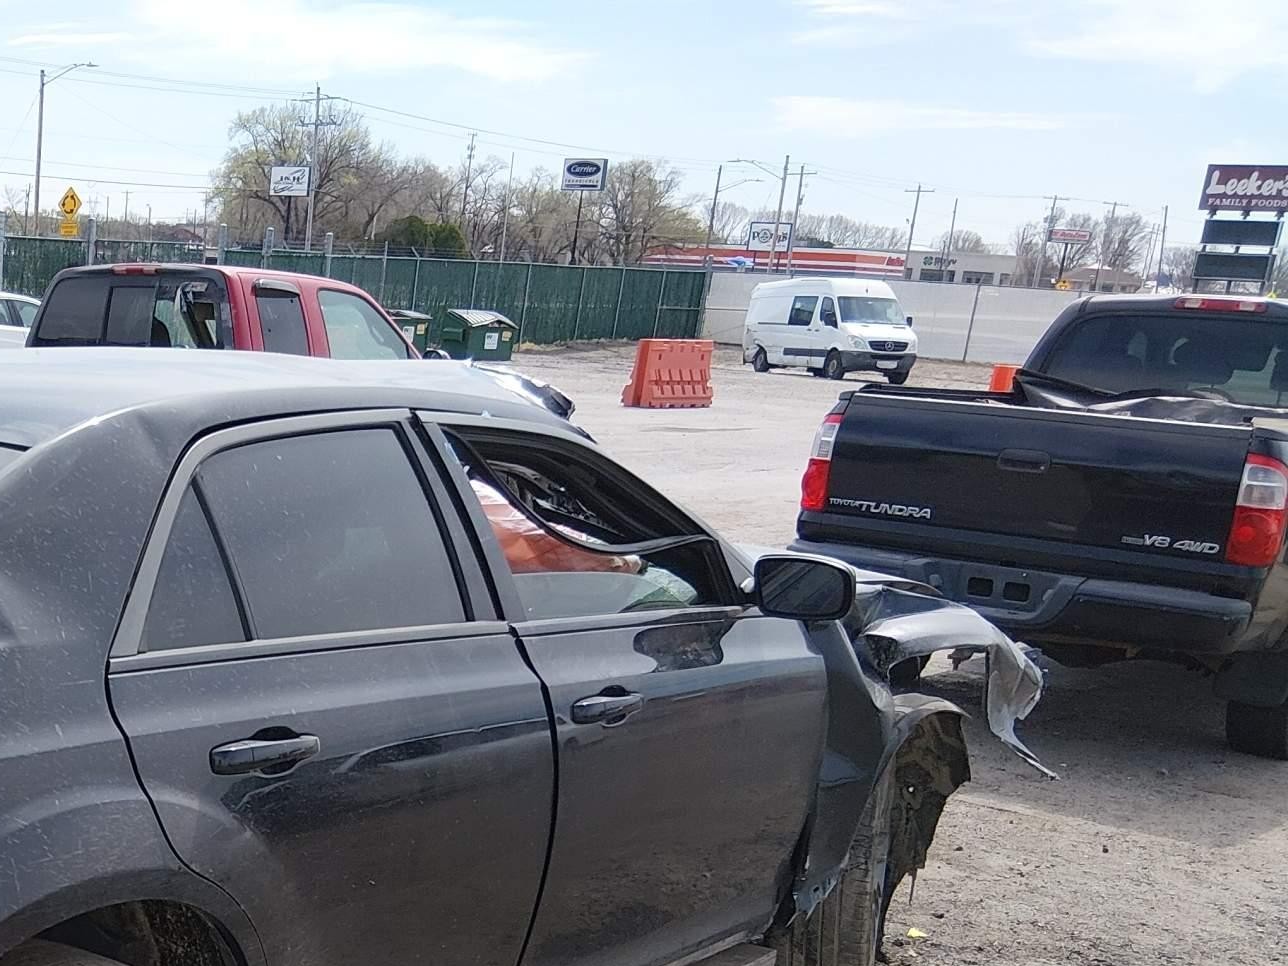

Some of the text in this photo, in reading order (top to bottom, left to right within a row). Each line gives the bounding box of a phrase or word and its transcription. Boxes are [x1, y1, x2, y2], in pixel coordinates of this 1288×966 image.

[570, 165, 597, 174] Carrier
[1208, 198, 1288, 208] FAMILY FOODS
[829, 498, 932, 520] TOYOTA TUNDRA
[1144, 534, 1171, 548] V8
[1173, 540, 1220, 554] 4WD
